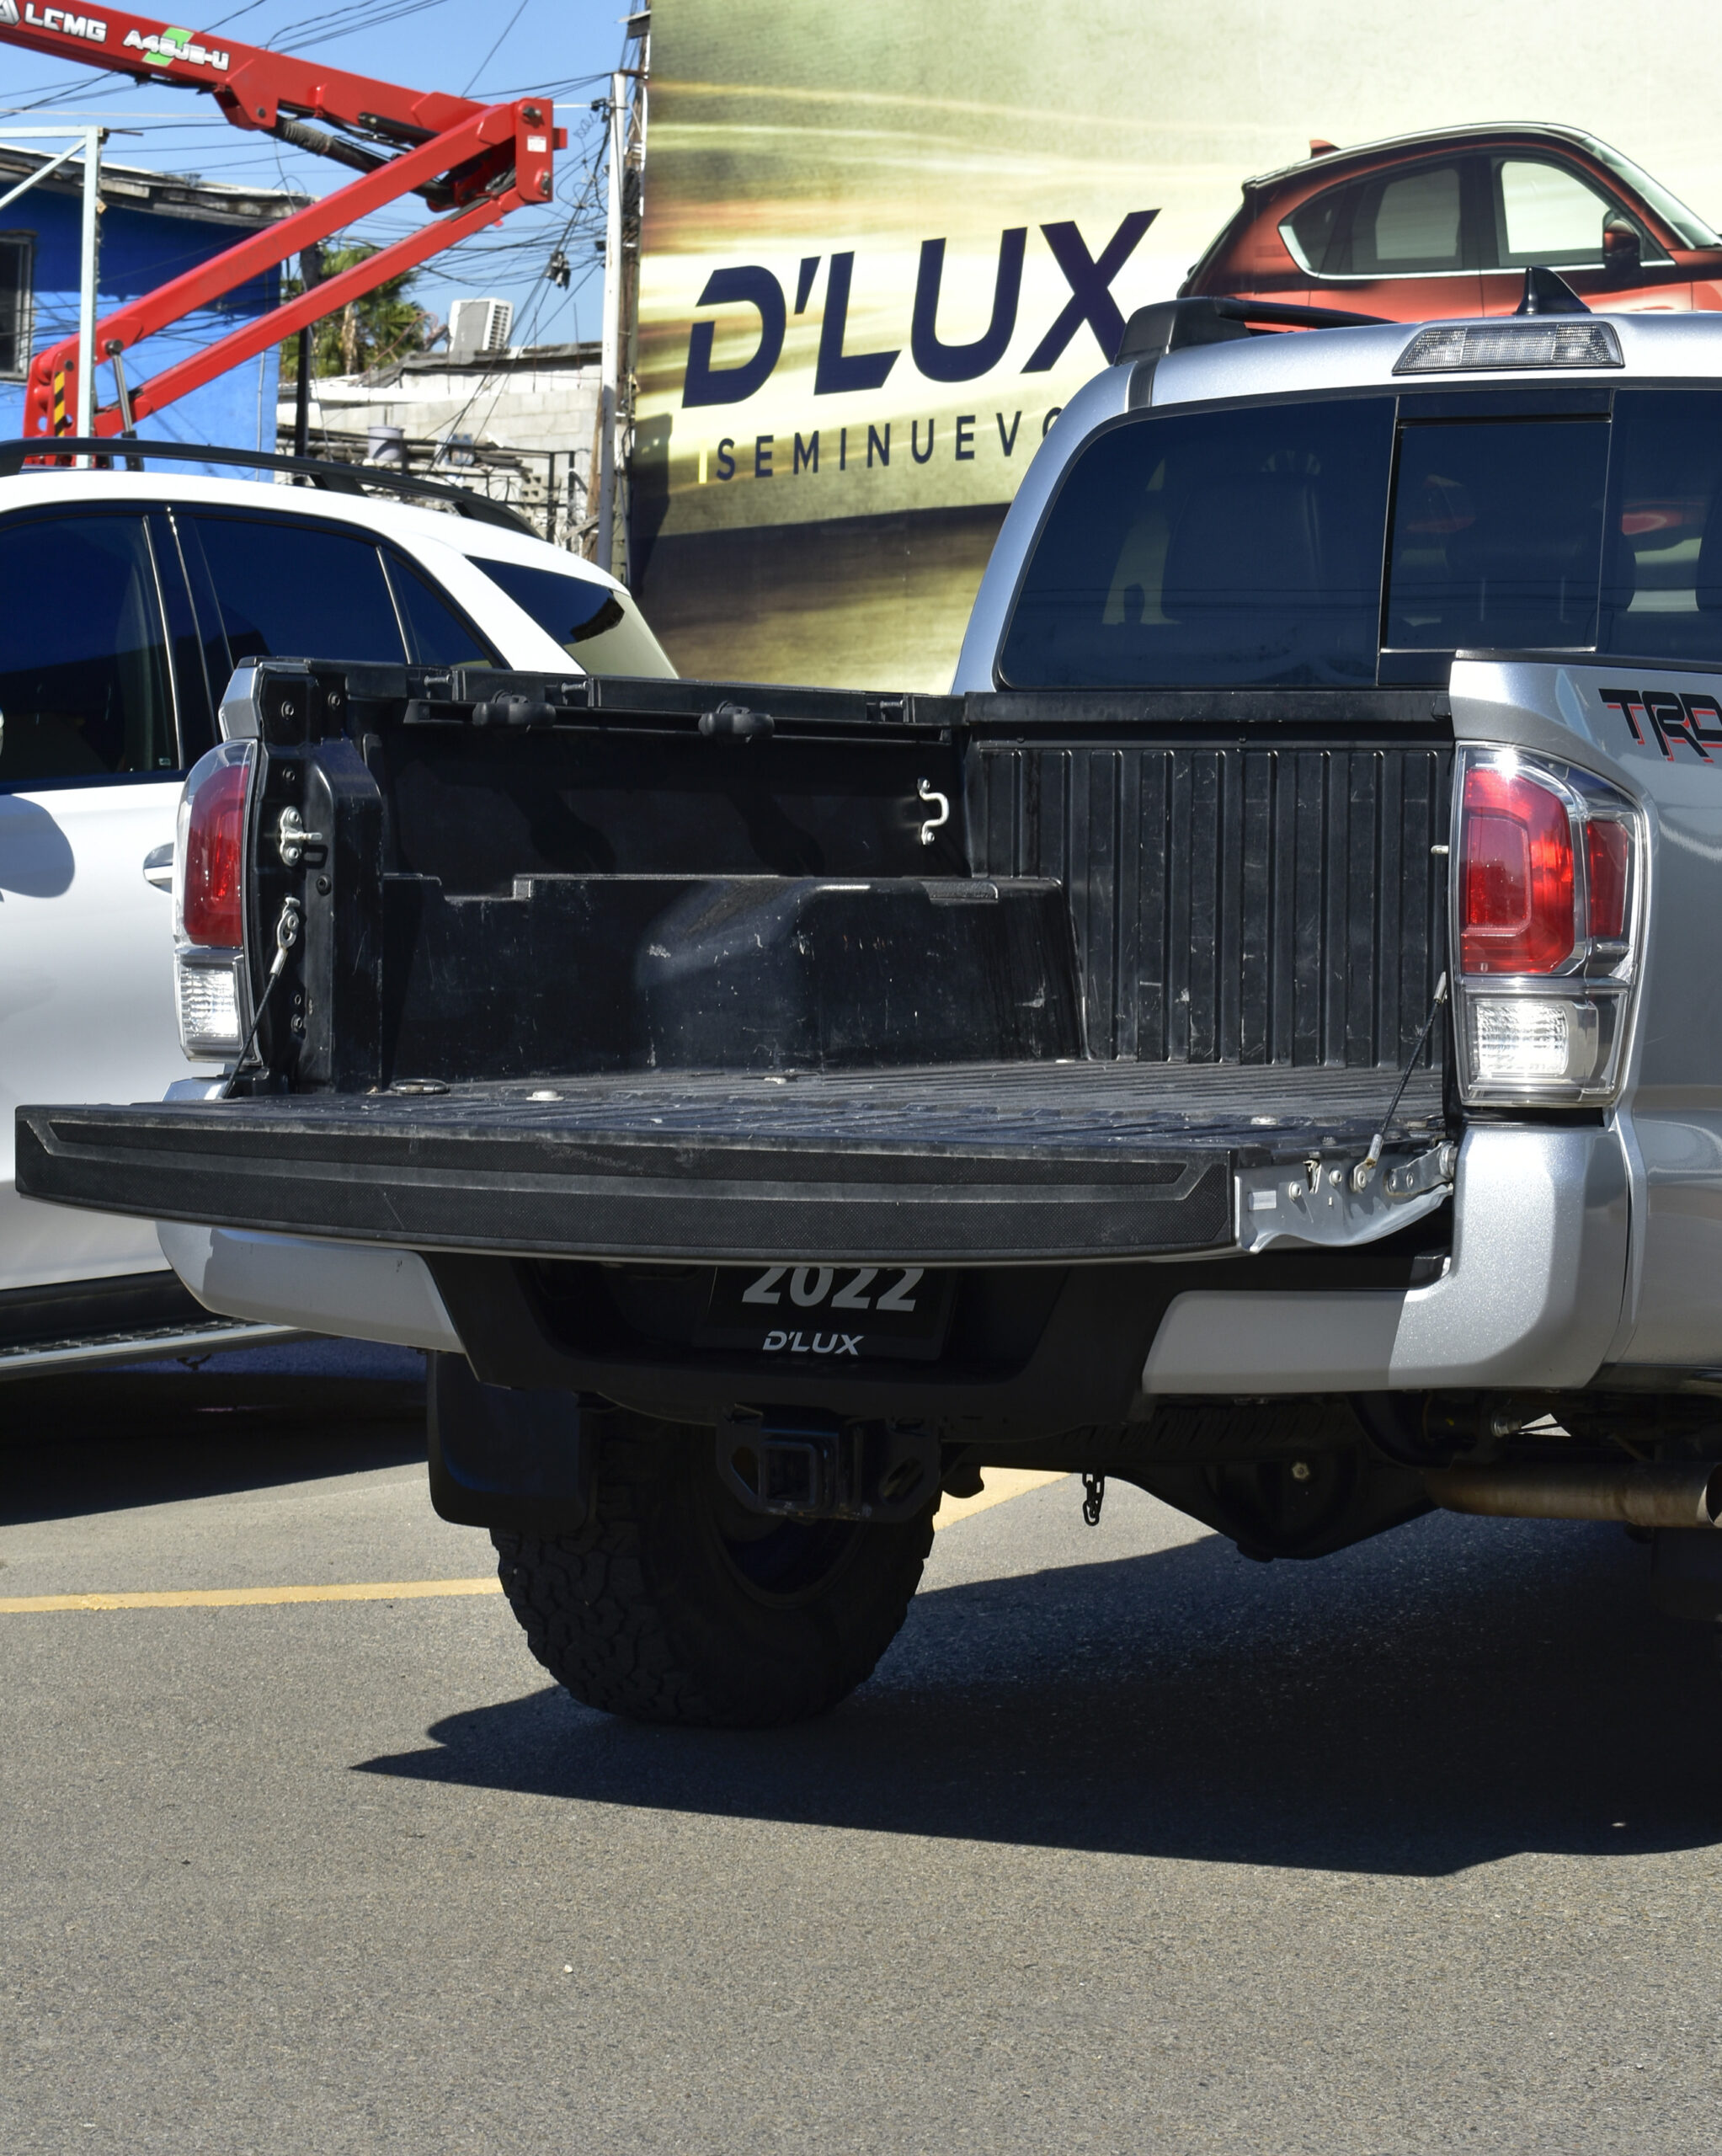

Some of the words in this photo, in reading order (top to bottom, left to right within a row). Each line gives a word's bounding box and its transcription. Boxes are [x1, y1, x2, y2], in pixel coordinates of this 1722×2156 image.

[682, 208, 1161, 408] D'LUX
[1598, 688, 1722, 763] TRD
[741, 1266, 925, 1311] 2022
[762, 1331, 864, 1355] D'LUX
